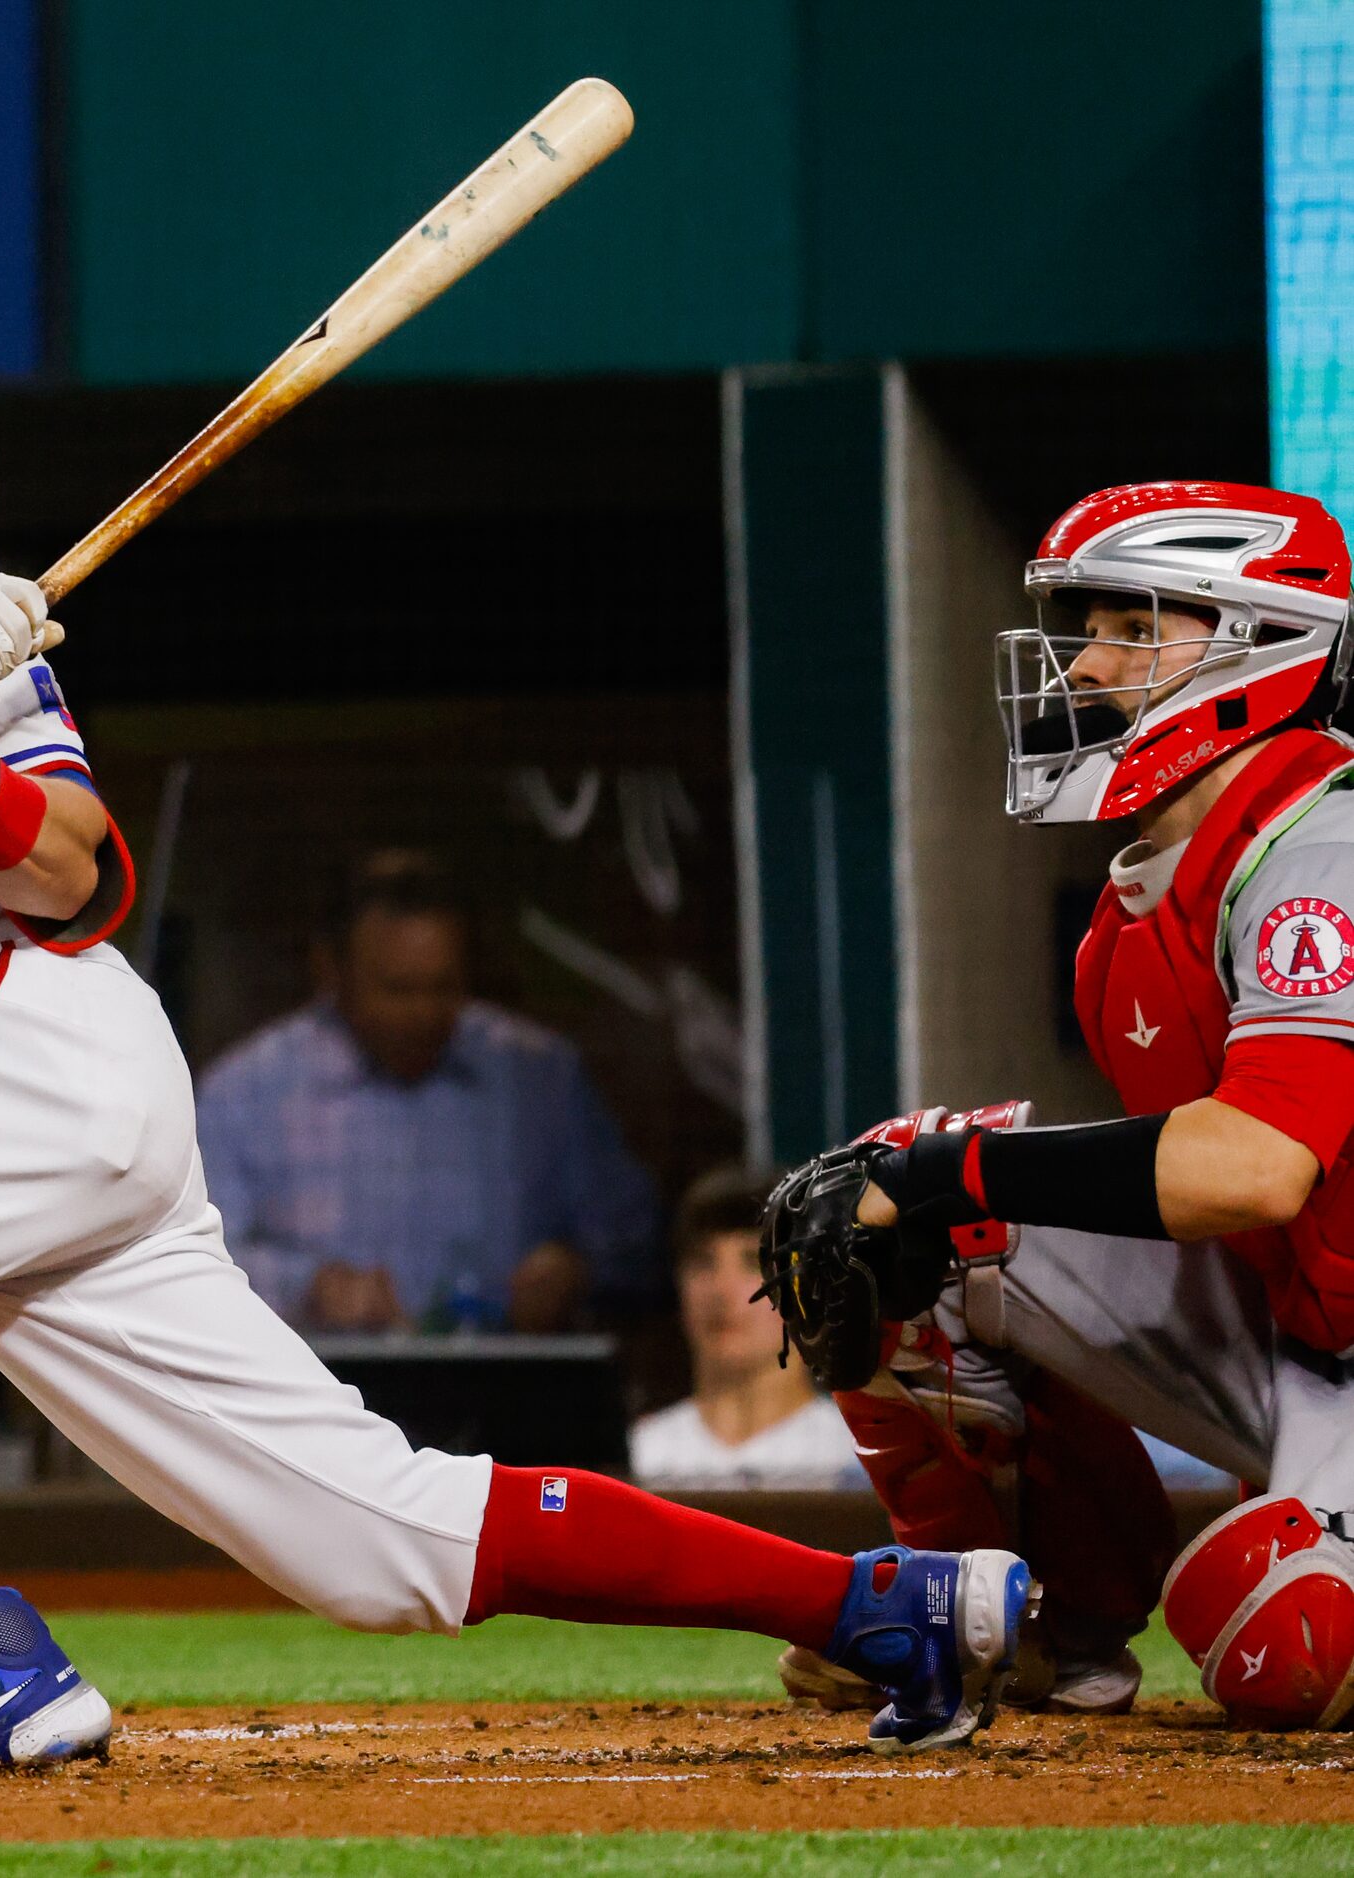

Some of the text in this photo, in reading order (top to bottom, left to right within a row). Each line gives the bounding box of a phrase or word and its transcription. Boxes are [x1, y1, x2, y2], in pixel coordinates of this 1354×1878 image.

[1267, 900, 1344, 928] ANGELS
[1259, 946, 1273, 965] 19
[1289, 916, 1327, 976] A
[1261, 967, 1354, 995] BASEBALL
